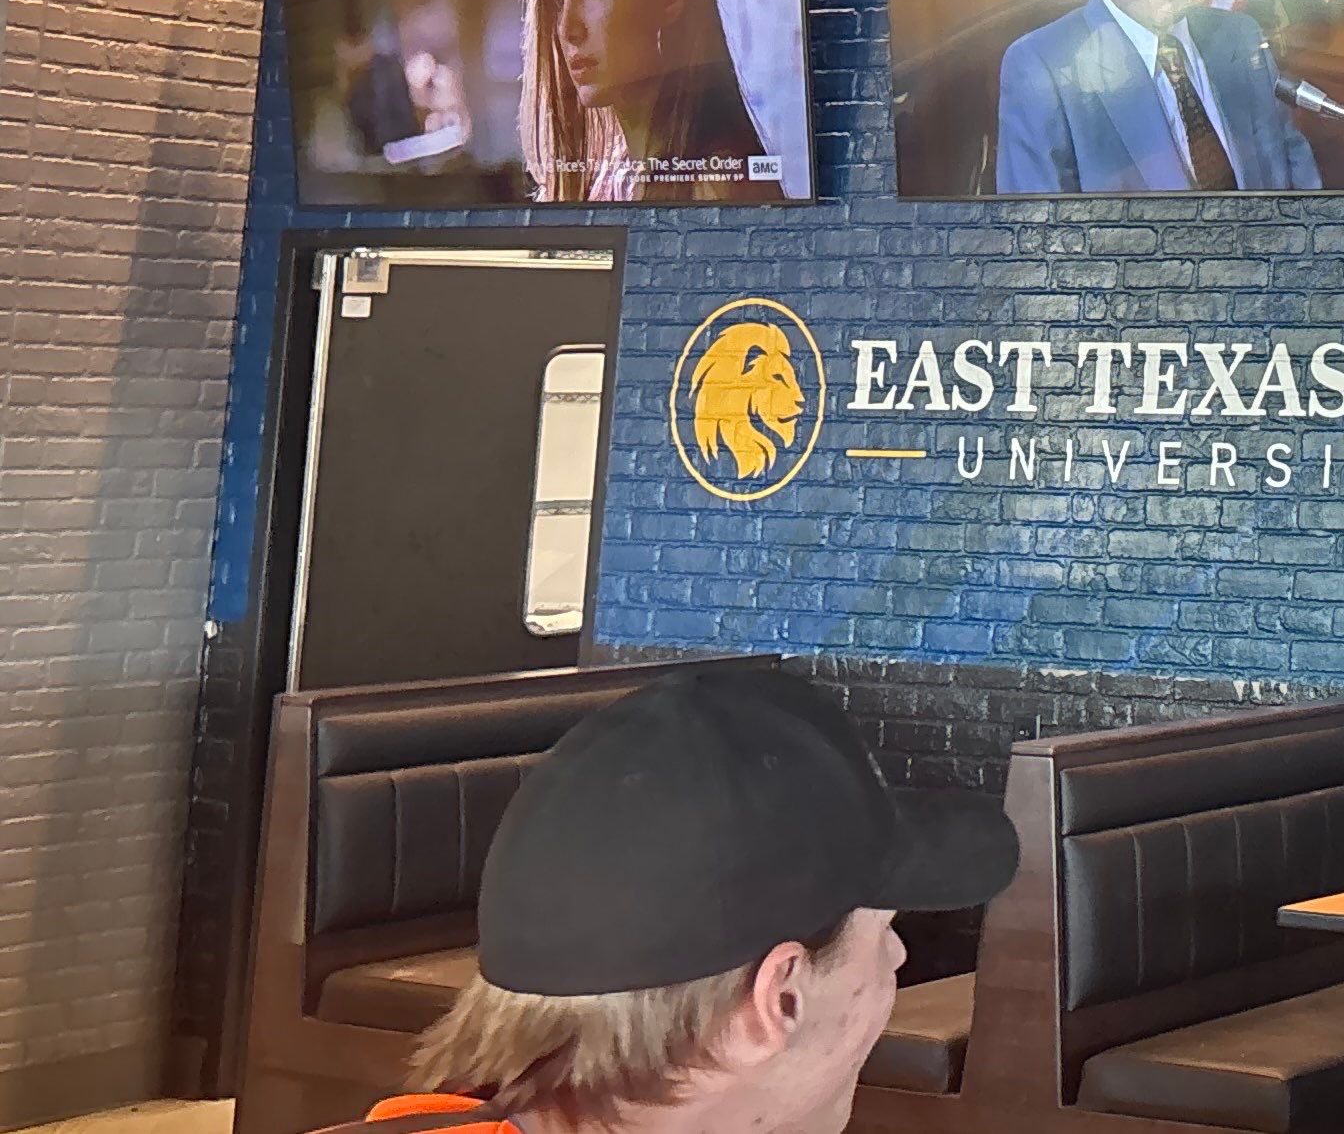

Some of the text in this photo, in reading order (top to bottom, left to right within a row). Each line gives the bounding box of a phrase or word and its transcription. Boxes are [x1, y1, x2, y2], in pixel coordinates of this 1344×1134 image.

[648, 157, 669, 171] The
[672, 157, 707, 170] Secret
[710, 156, 743, 170] Order
[698, 173, 731, 181] SUNDAY
[847, 339, 1051, 412] EAST
